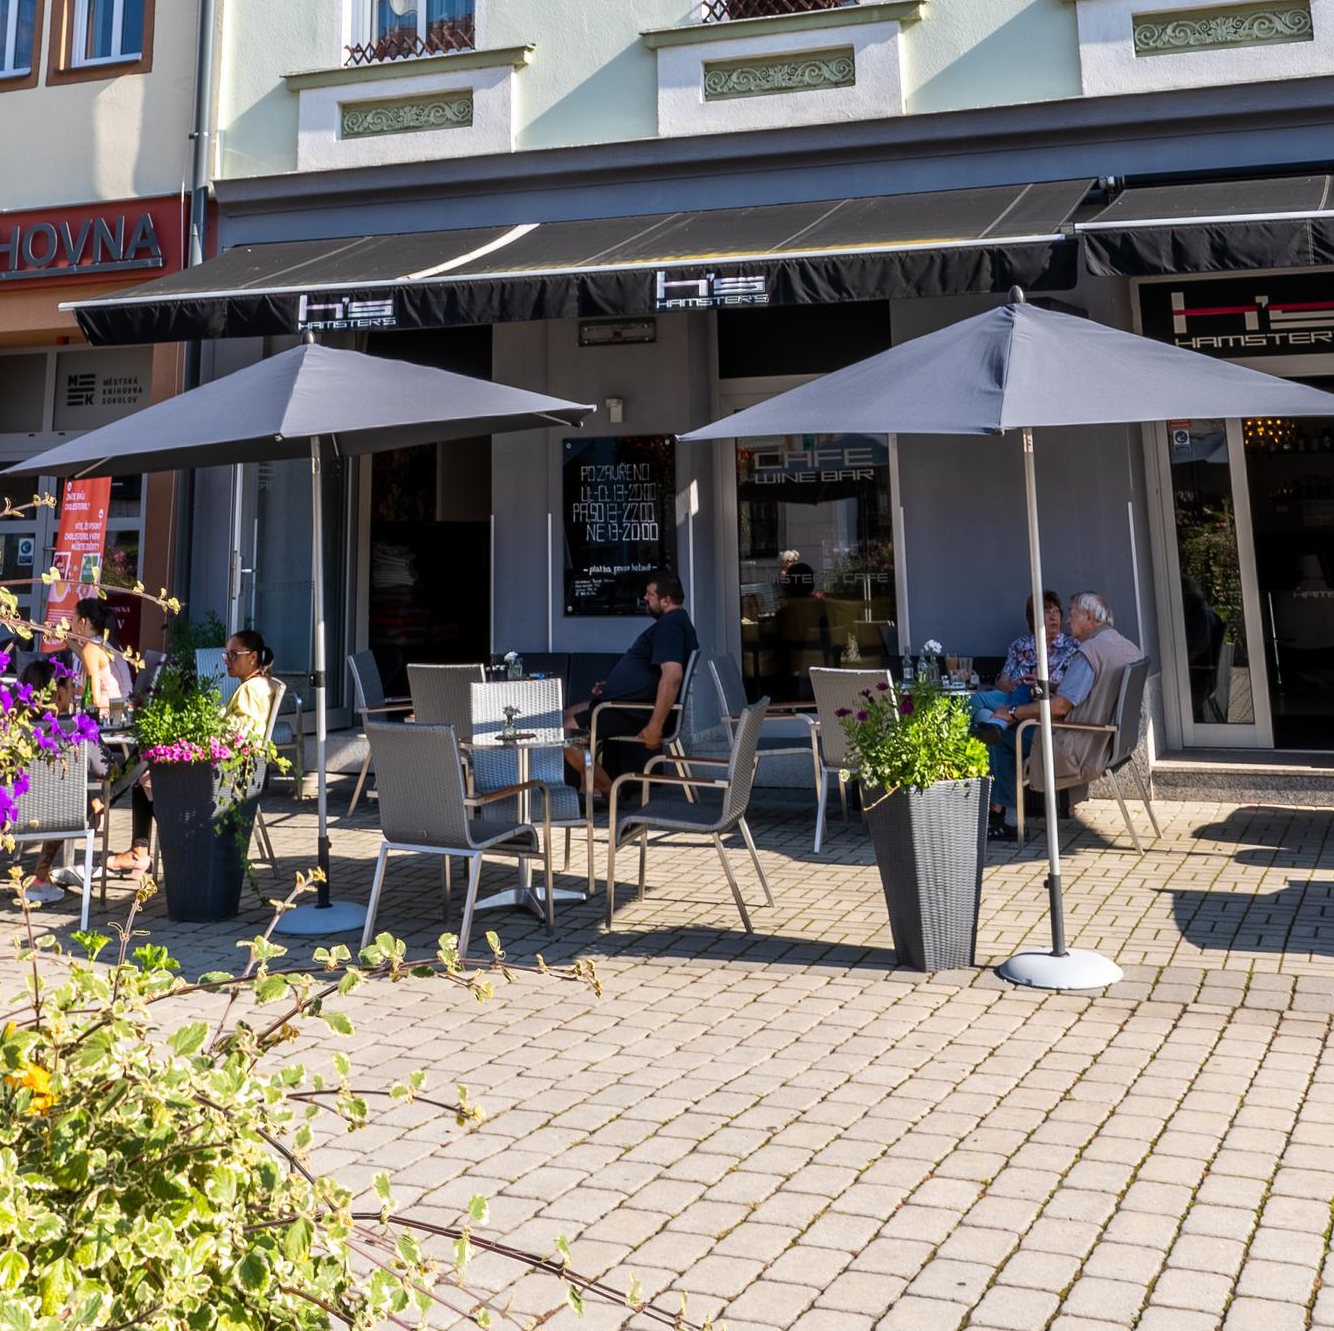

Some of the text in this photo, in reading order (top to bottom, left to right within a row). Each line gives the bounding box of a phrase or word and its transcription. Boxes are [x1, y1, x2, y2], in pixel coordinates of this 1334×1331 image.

[656, 294, 770, 309] HAMSTER'S
[298, 317, 397, 330] HAMSTER'S
[102, 387, 143, 395] KNIHOVNA
[102, 396, 138, 405] SOKOLOV
[754, 448, 875, 470] CAFE
[755, 469, 875, 484] WINE BAR
[586, 524, 605, 542] NE
